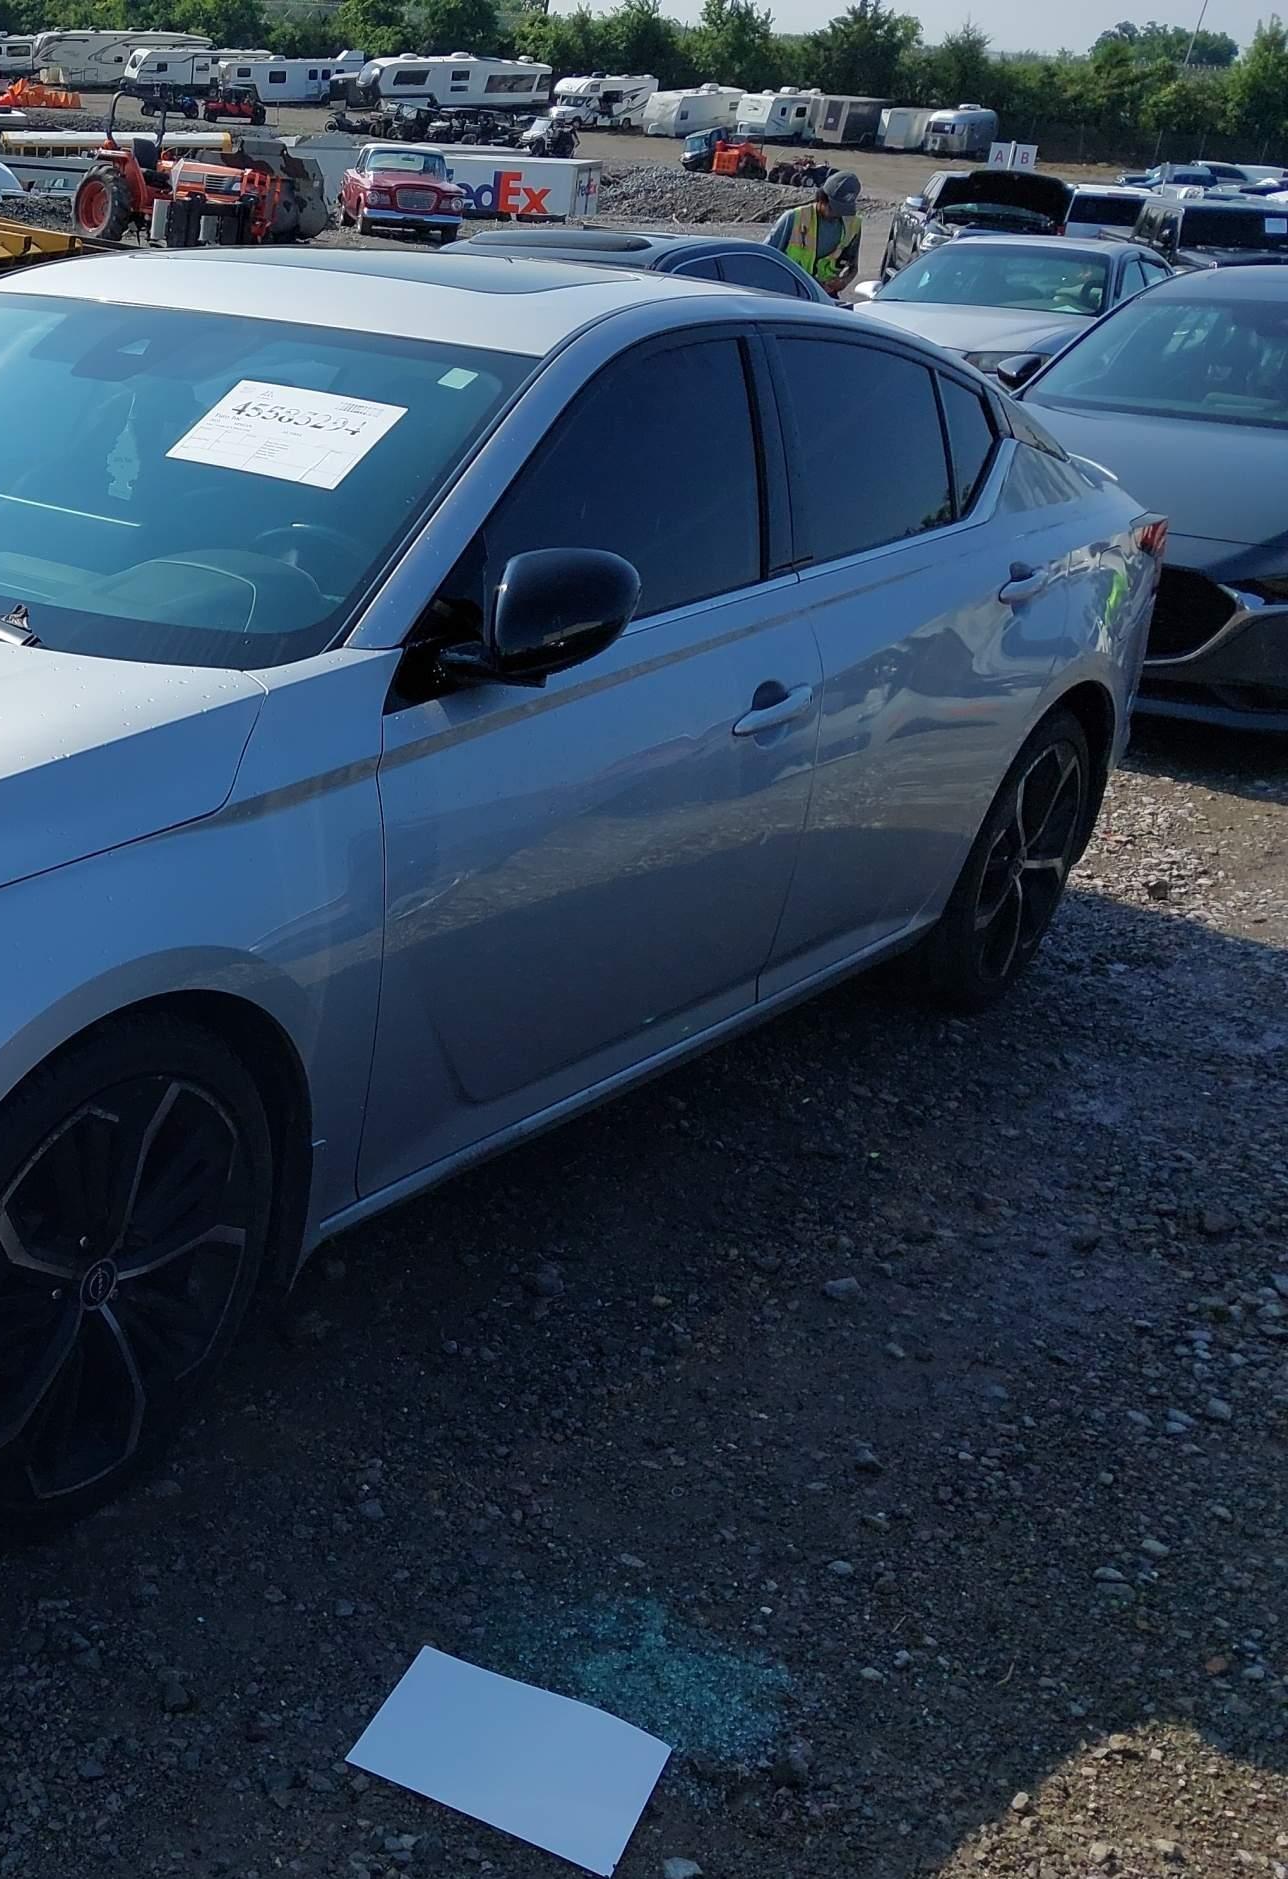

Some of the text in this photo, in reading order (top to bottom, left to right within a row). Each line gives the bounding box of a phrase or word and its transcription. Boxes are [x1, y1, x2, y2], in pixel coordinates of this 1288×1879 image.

[993, 150, 1004, 163] A
[1020, 152, 1029, 165] B
[455, 170, 552, 215] edEx
